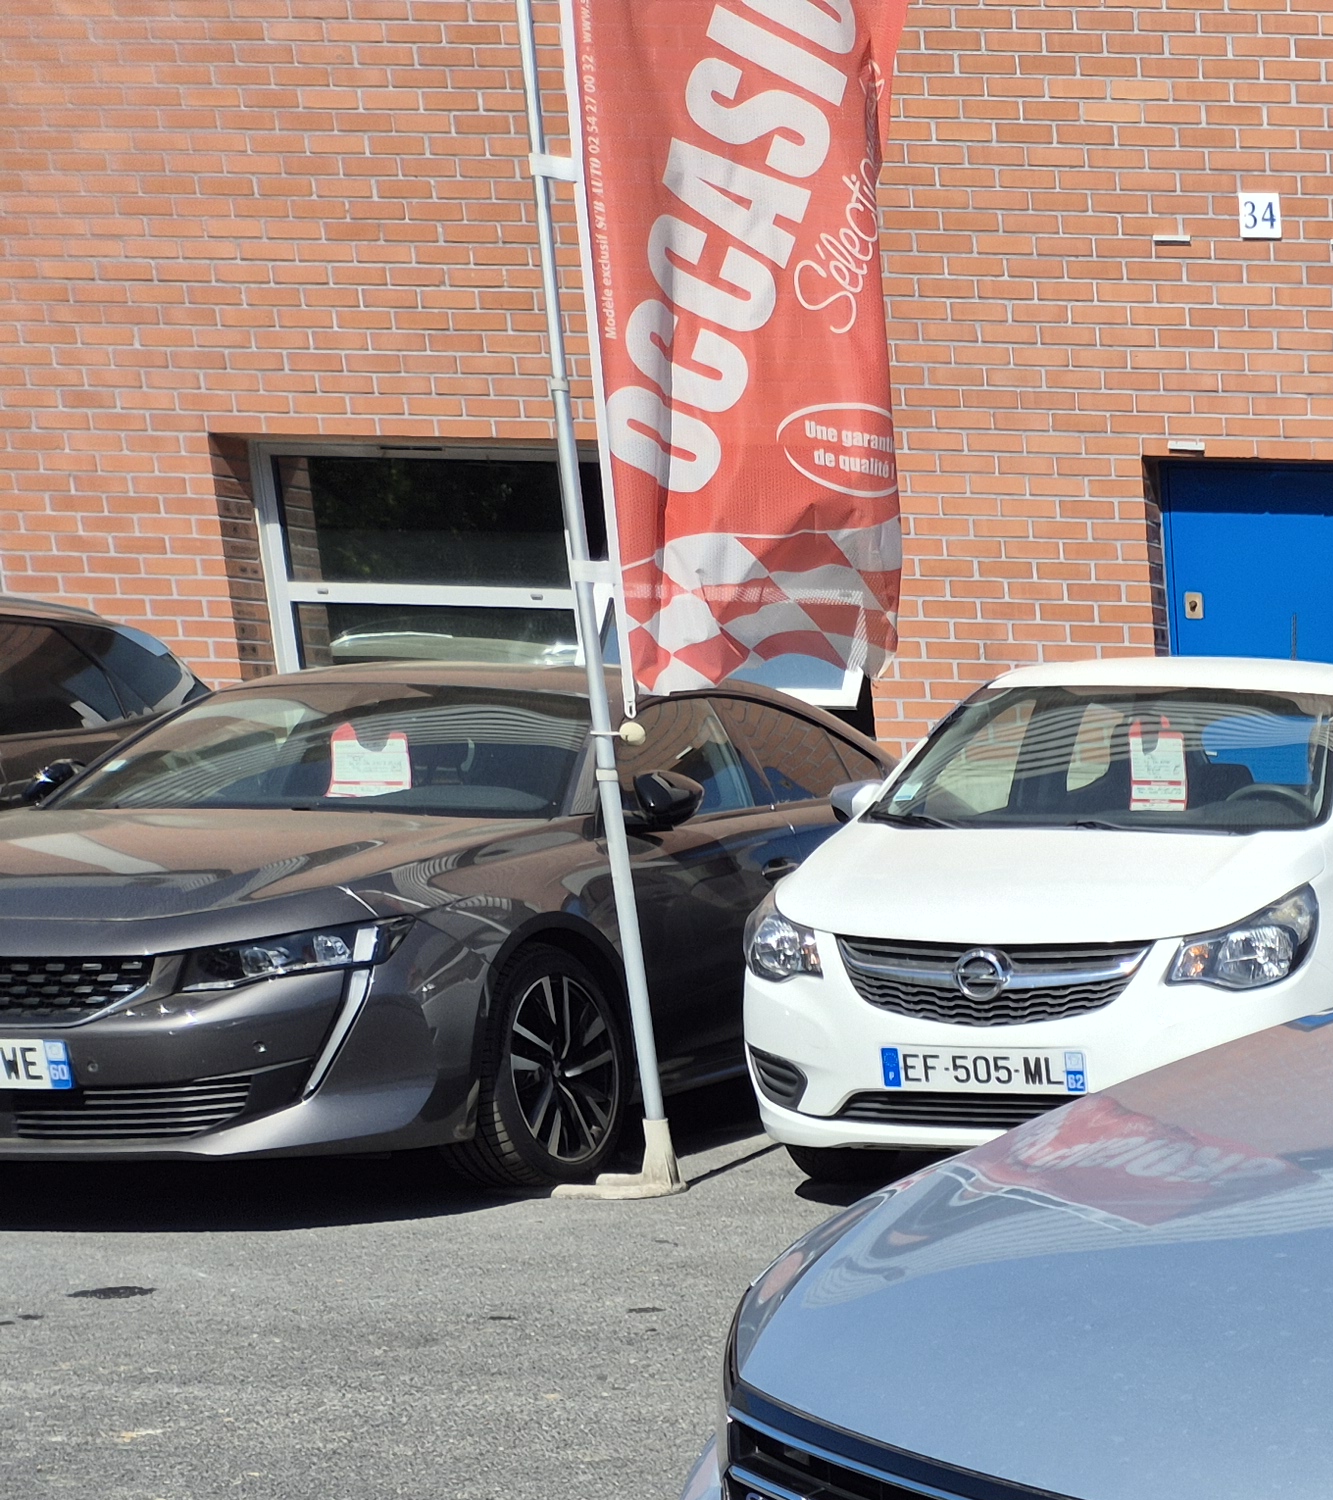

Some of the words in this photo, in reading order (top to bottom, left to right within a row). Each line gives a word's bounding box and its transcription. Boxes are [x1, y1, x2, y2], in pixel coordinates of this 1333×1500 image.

[582, 54, 595, 73] 32
[583, 74, 596, 93] 00
[584, 95, 597, 113] 27
[586, 114, 599, 134] 54
[588, 135, 601, 155] 02
[1243, 201, 1277, 229] 34
[596, 233, 612, 286] exclusif
[804, 419, 838, 442] Une
[813, 447, 836, 468] de
[50, 1064, 70, 1081] 60
[902, 1053, 1064, 1085] EF-505-ML
[1066, 1073, 1086, 1090] 62
